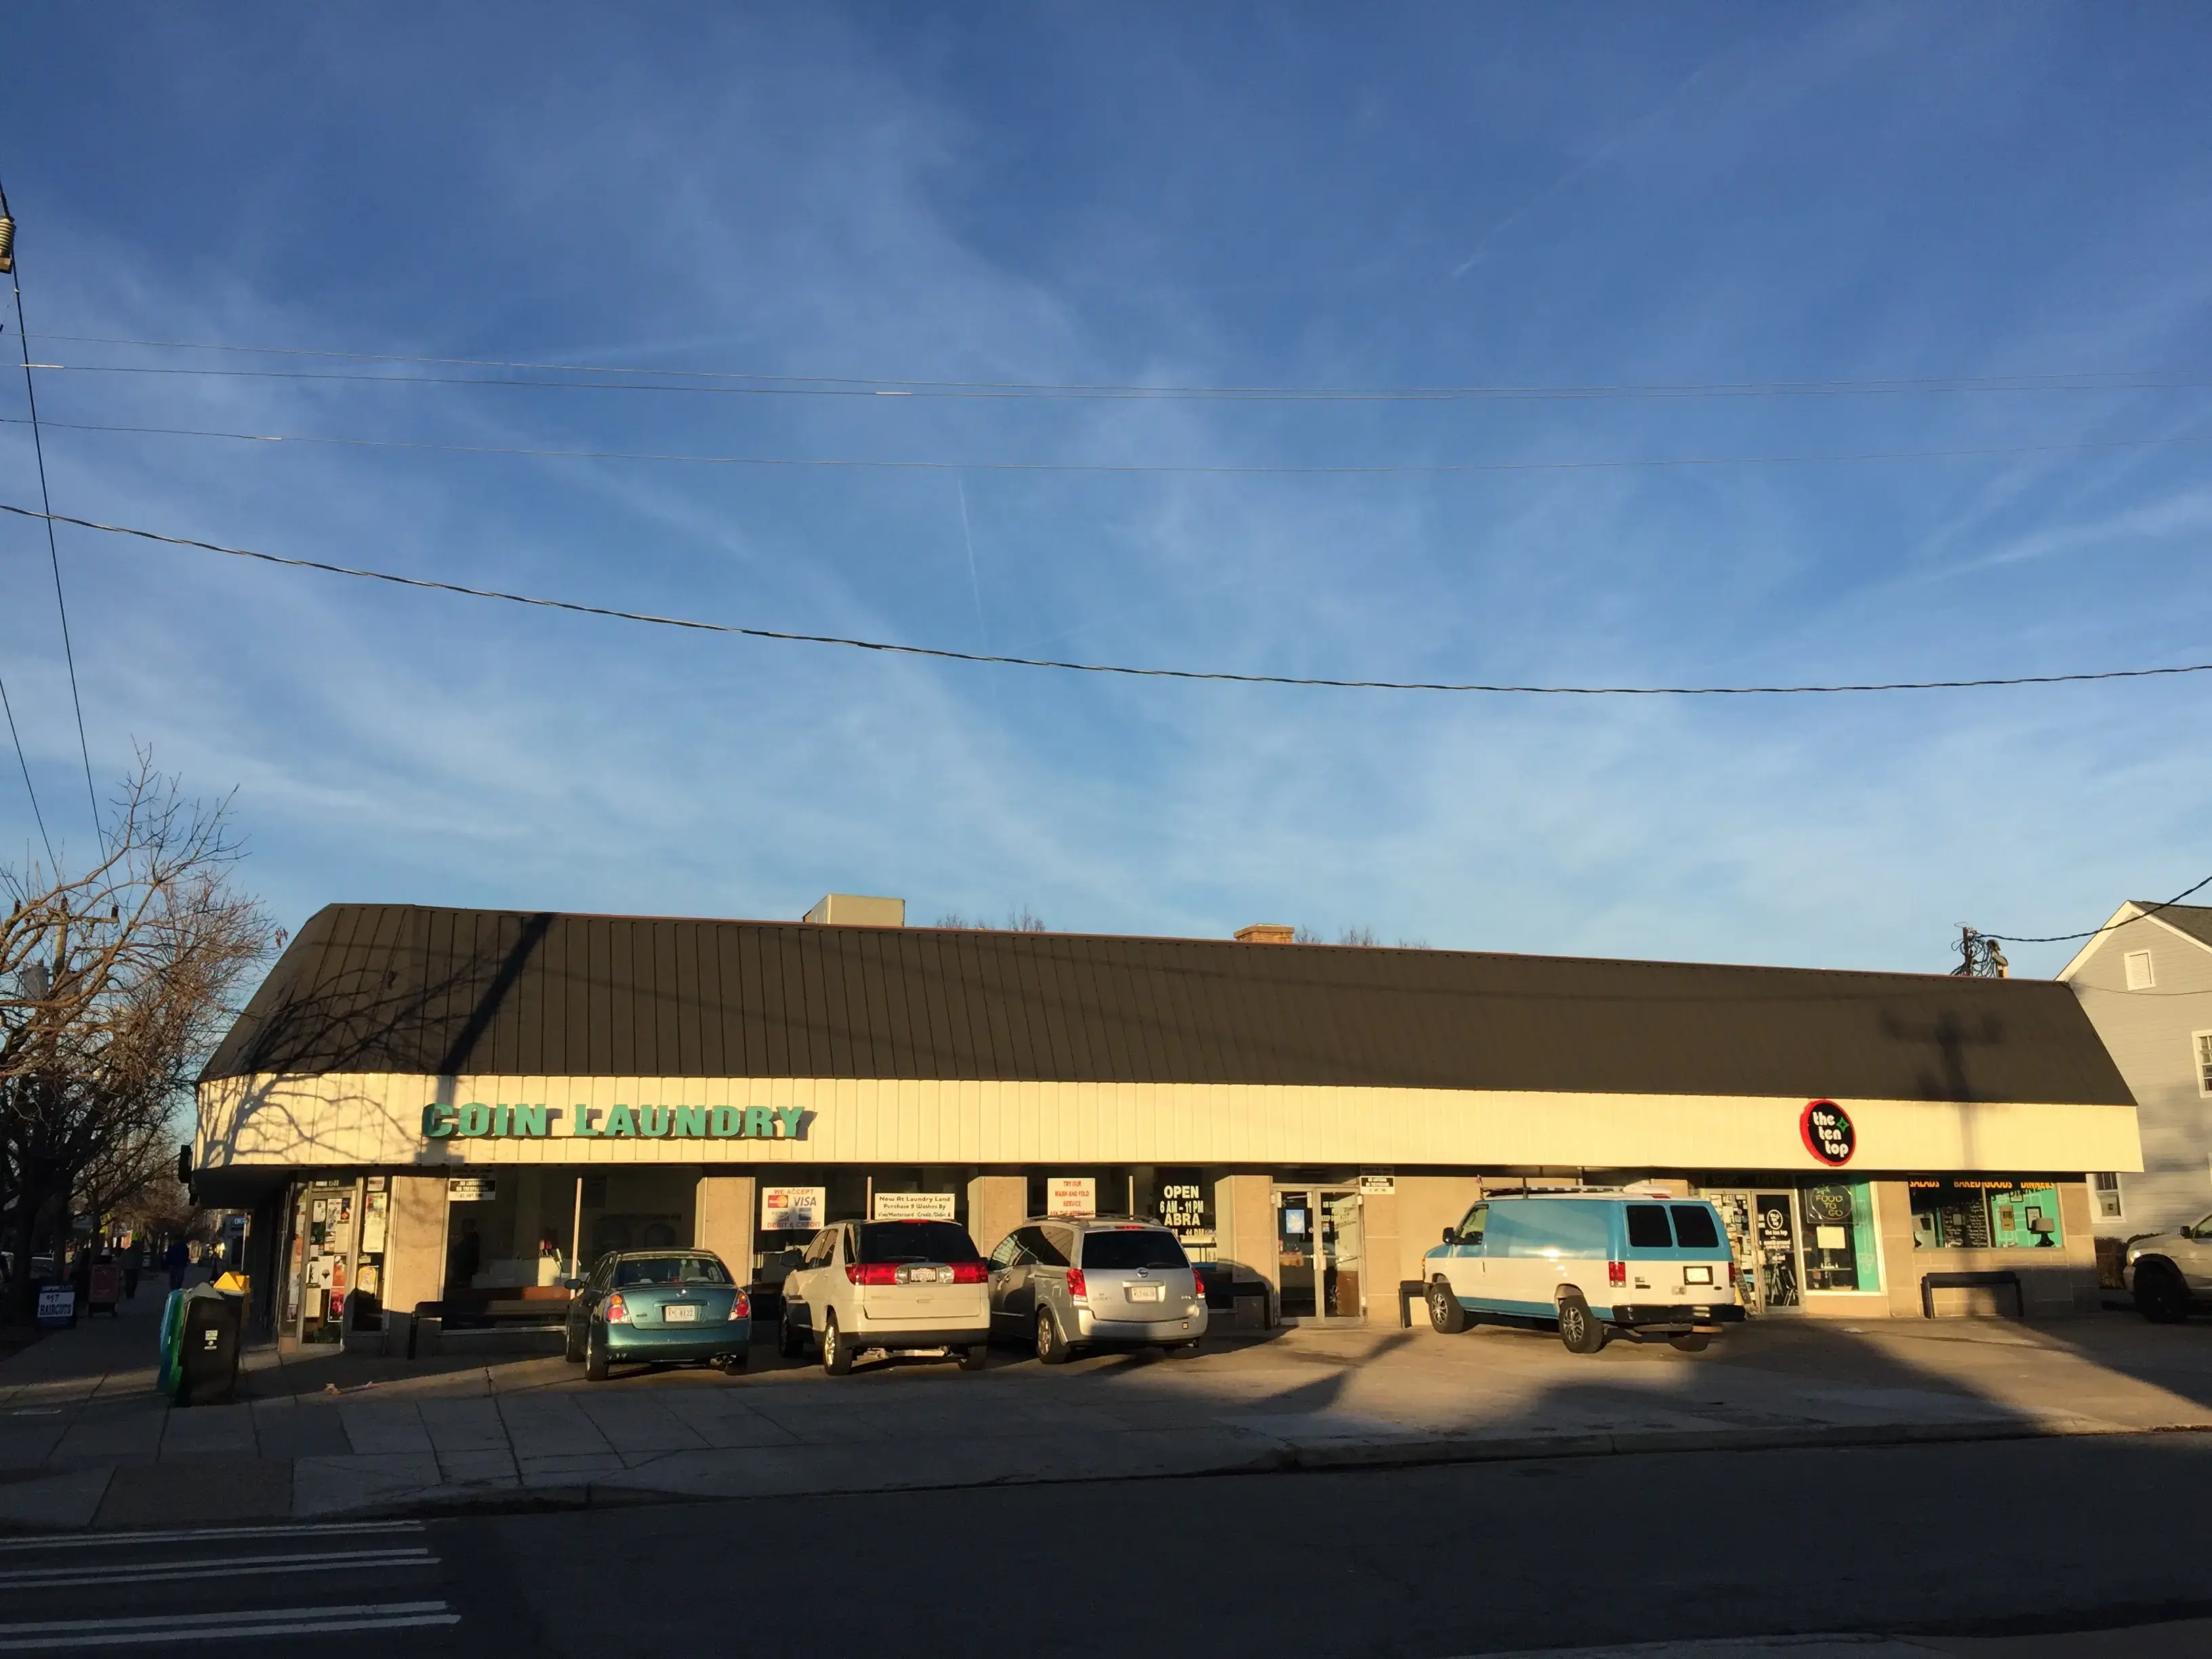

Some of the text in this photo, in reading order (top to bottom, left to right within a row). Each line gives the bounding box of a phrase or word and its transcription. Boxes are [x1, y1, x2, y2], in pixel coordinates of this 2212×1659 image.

[421, 1103, 805, 1137] COIN LAUNDRY
[1812, 1111, 1835, 1126] the
[1818, 1126, 1842, 1140] ten
[1824, 1140, 1849, 1158] top
[1164, 1185, 1200, 1199] OPEN
[793, 1197, 817, 1206] VISA
[1160, 1200, 1165, 1213] 6
[1166, 1200, 1178, 1213] AM
[1185, 1200, 1191, 1213] 11
[1193, 1200, 1204, 1213] PM
[1164, 1212, 1201, 1226] ABRA
